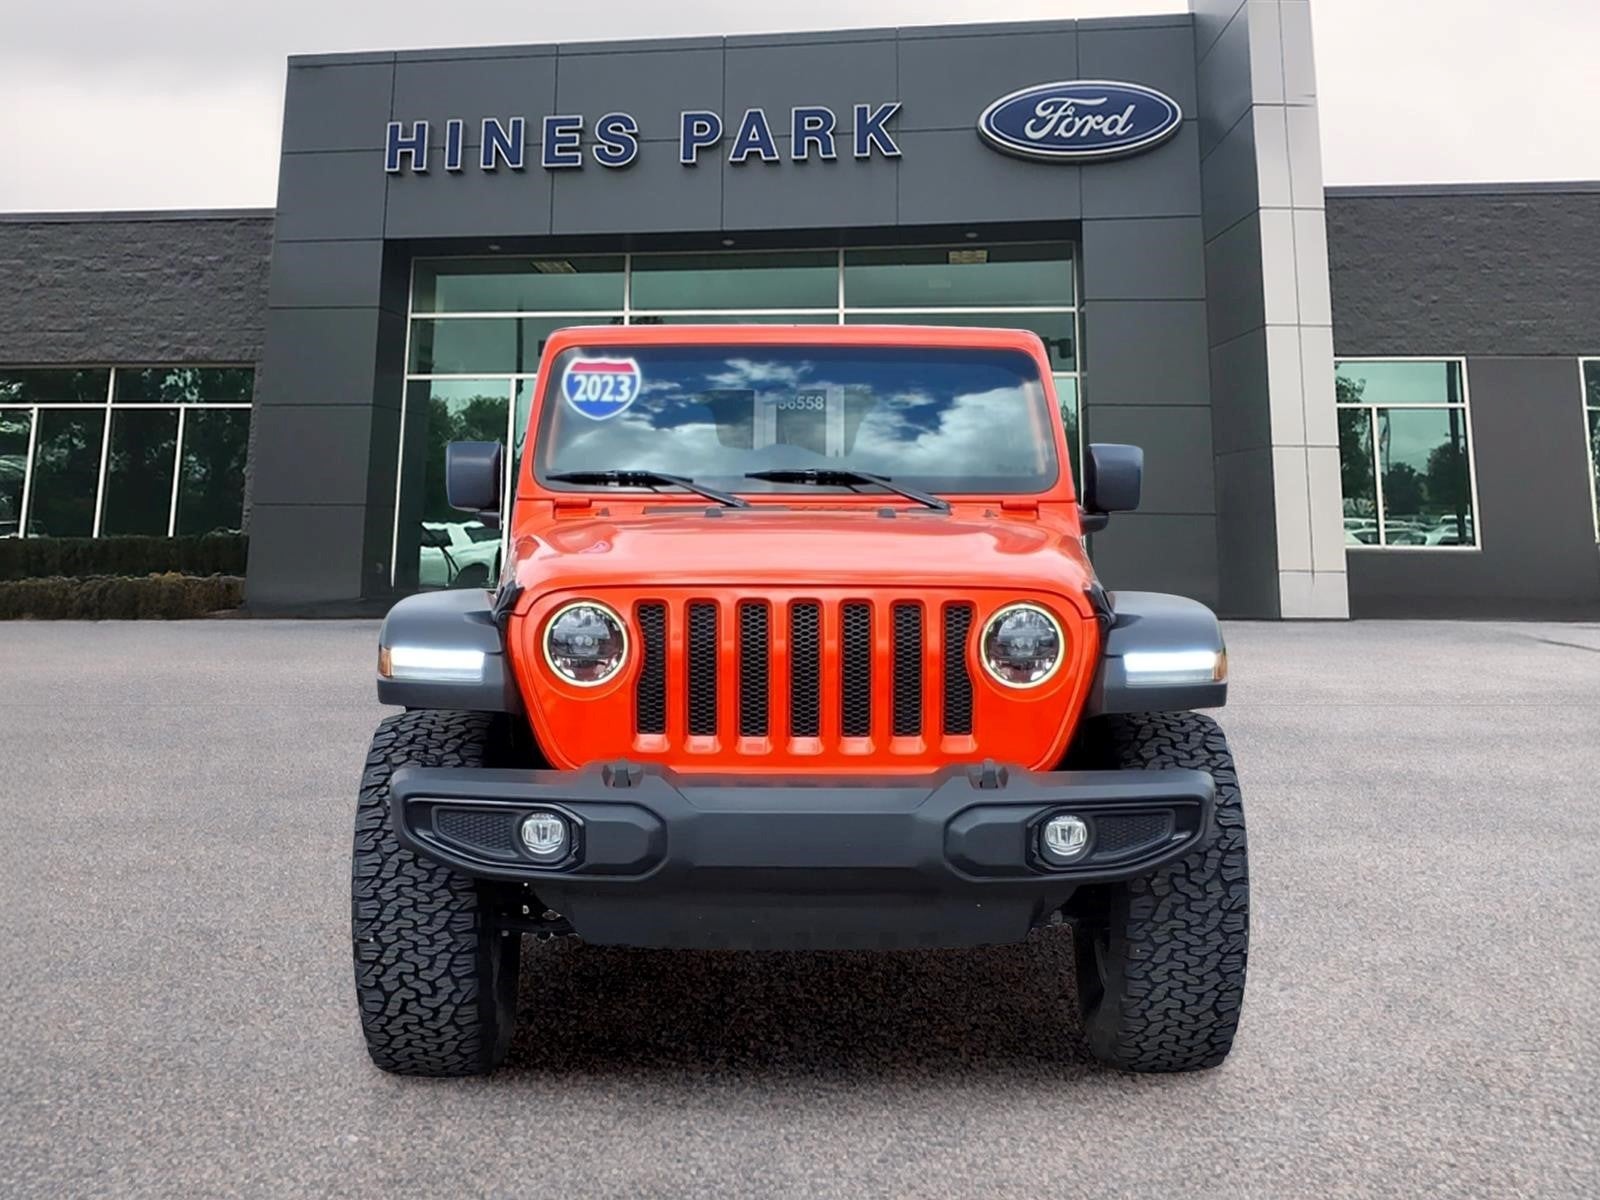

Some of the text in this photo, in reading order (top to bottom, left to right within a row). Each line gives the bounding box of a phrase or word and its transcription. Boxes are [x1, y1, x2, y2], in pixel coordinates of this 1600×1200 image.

[384, 103, 902, 173] HINES PARK
[1024, 97, 1136, 140] Ford
[572, 374, 632, 402] 2023
